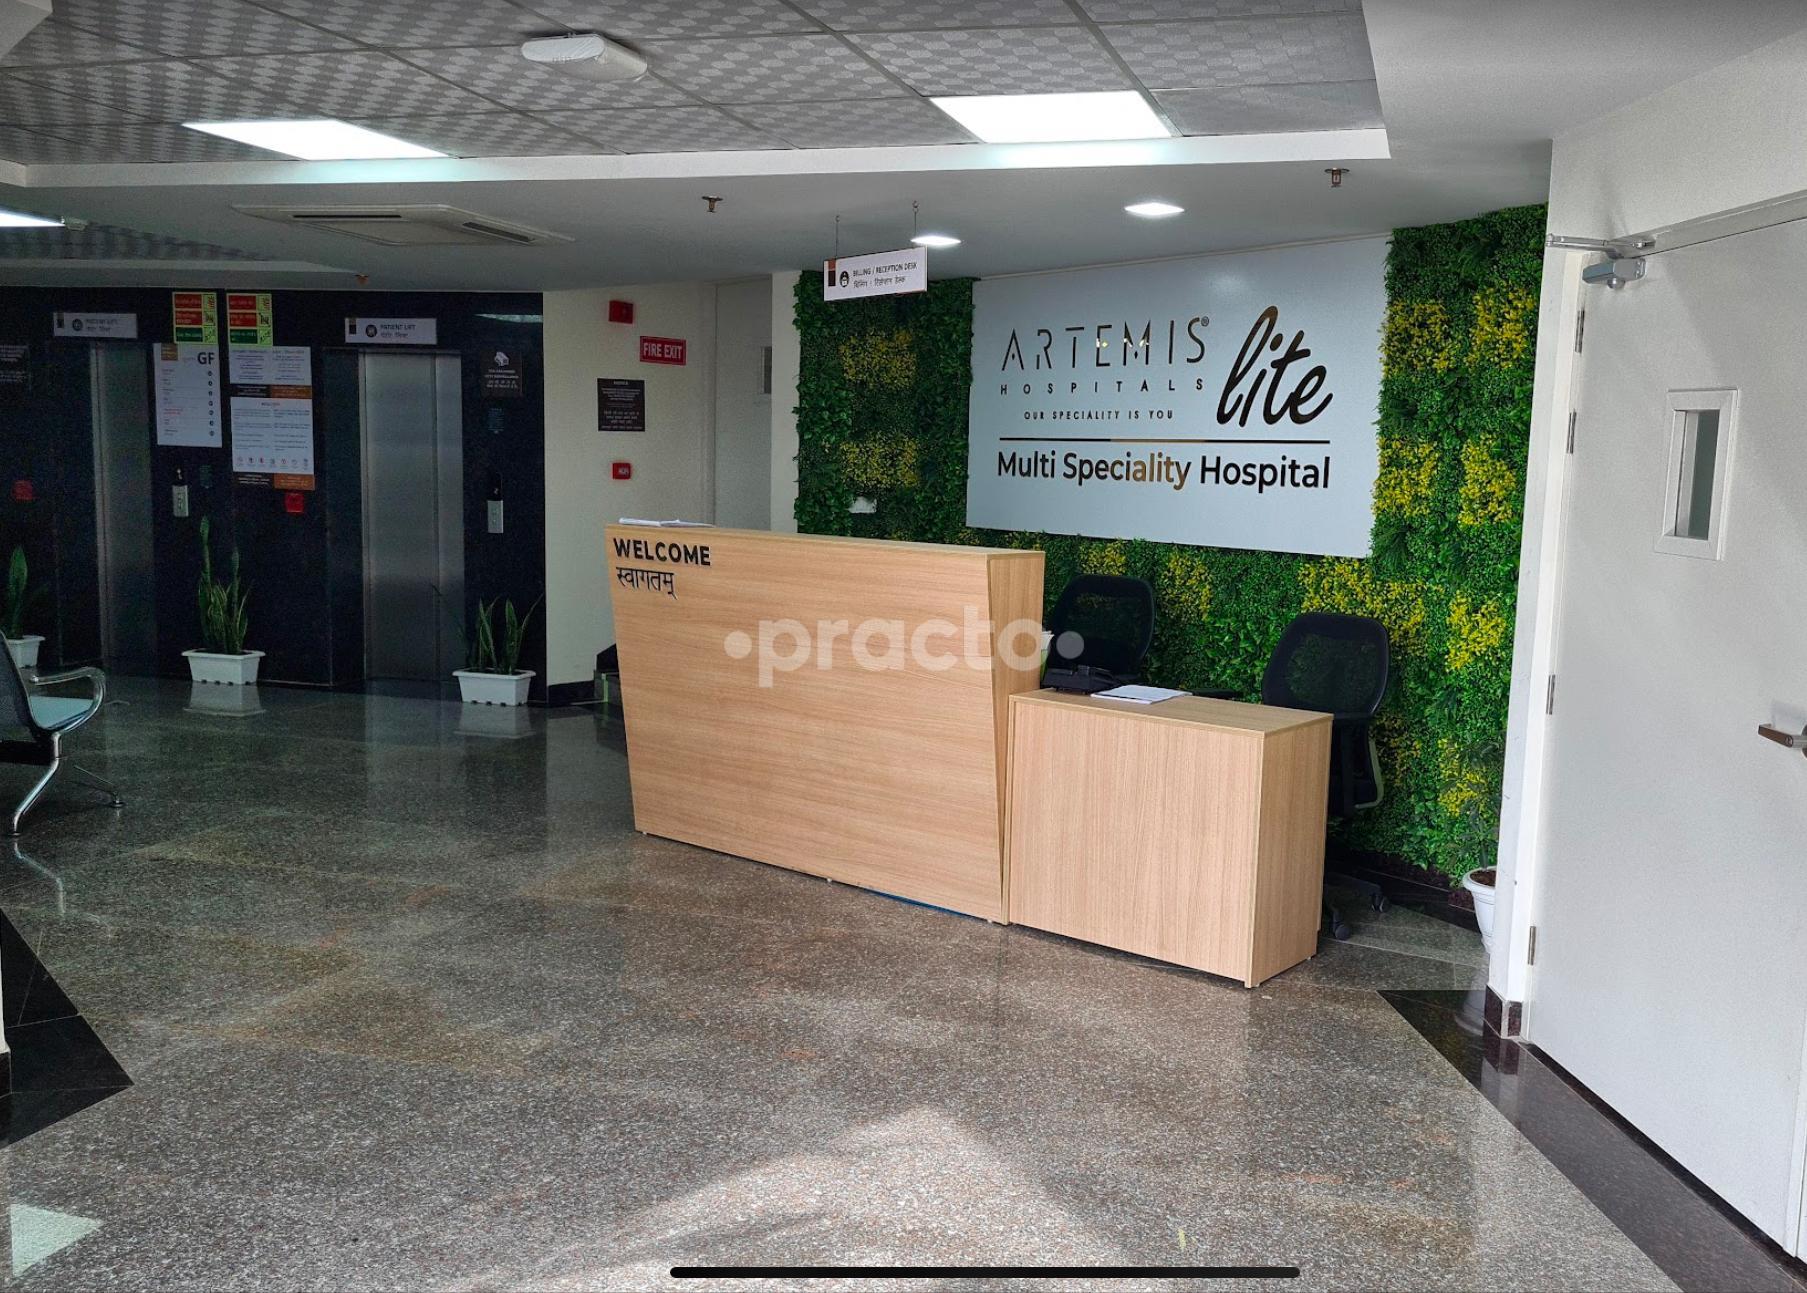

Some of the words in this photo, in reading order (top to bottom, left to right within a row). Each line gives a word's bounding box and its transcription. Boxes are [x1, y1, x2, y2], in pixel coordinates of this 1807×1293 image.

[853, 267, 871, 277] BILLING
[876, 264, 903, 274] RECEPTION
[904, 261, 918, 271] DESK
[197, 351, 215, 366] GF
[643, 342, 662, 358] FIRE
[664, 344, 682, 359] EXIT
[1217, 305, 1333, 428] lite
[1000, 378, 1203, 395] HOSPITALS
[1024, 411, 1044, 420] OUR
[1052, 409, 1121, 420] SPECIALITY
[1128, 410, 1140, 420] IS
[1148, 410, 1174, 420] YOU
[998, 451, 1056, 479] Multi
[1063, 451, 1191, 491] Speciality
[1200, 455, 1330, 494] Hospital
[613, 537, 711, 567] WELCOME
[616, 566, 678, 600] स्वागतम्
